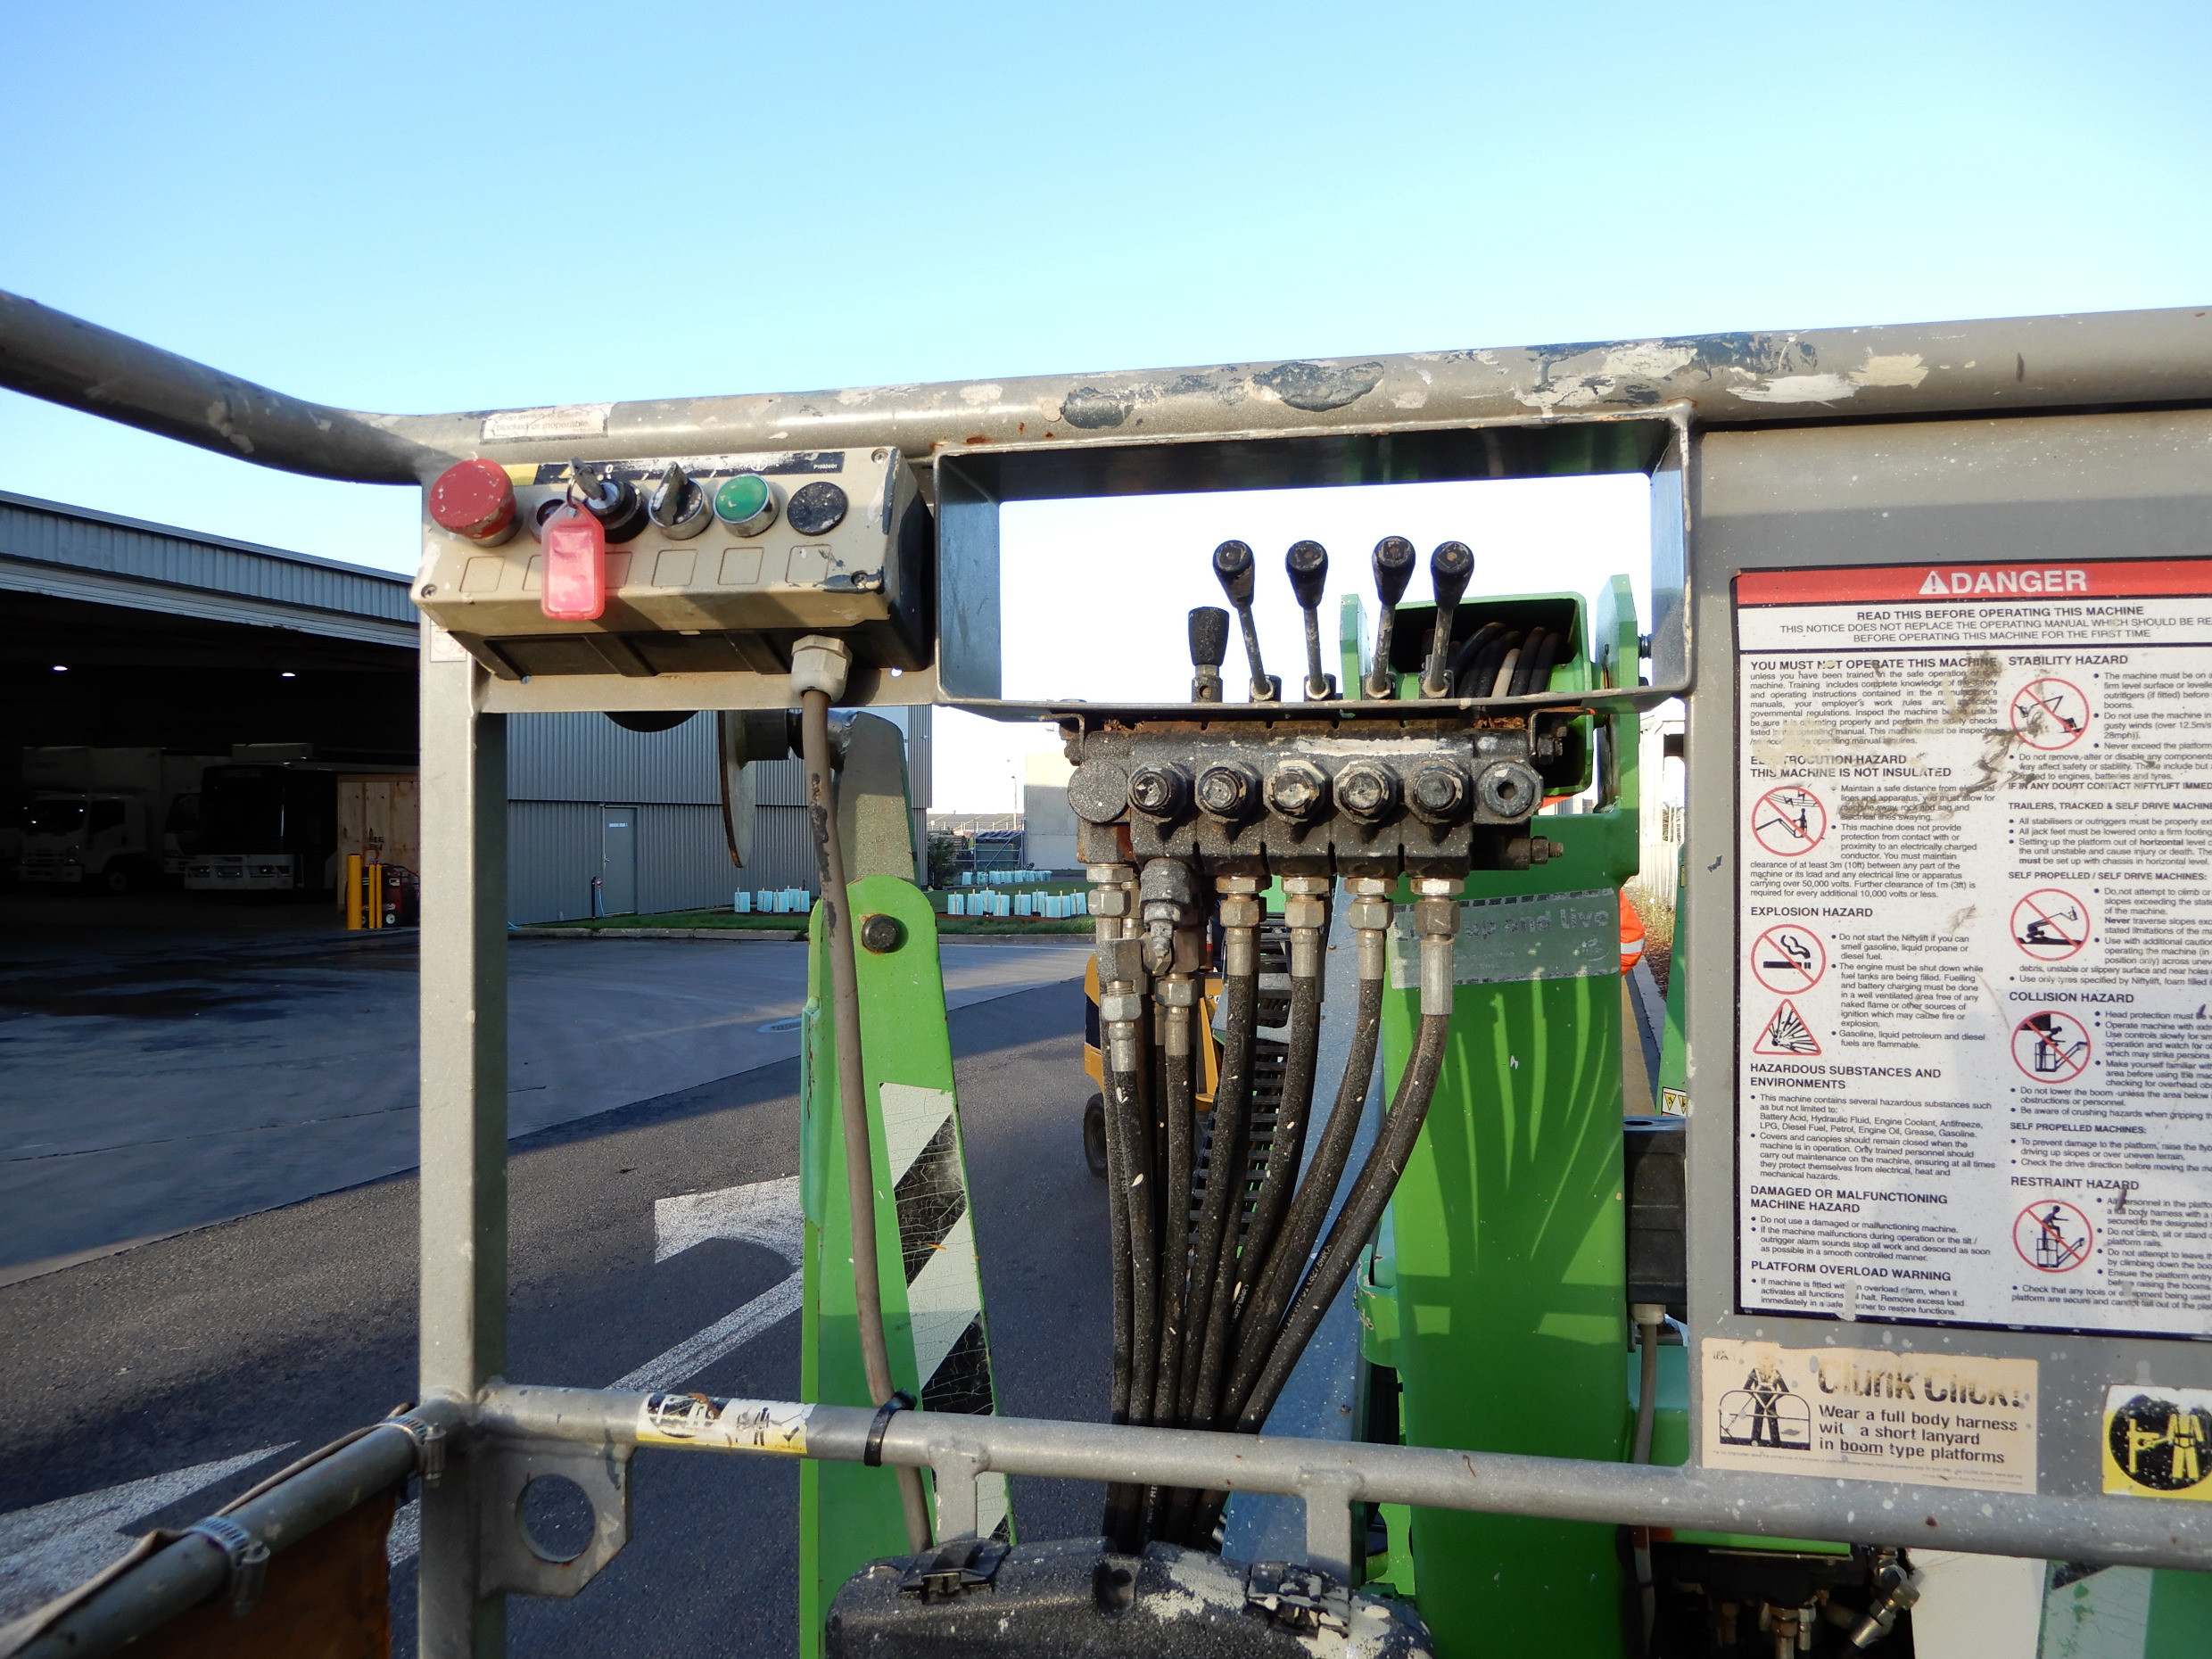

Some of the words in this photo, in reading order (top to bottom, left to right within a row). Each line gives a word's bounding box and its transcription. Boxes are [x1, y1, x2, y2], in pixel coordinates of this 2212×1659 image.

[496, 422, 529, 432] blocked
[1952, 570, 2087, 595] DANGER
[1857, 611, 1891, 621] READ
[1894, 610, 1922, 620] THIS
[1925, 609, 1976, 619] BEFORE
[1978, 607, 2051, 618] OPERATING
[2053, 607, 2083, 616] THIS
[2086, 606, 2144, 616] MACHINE
[1780, 625, 1803, 633] THIS
[1806, 624, 1845, 632] NOTICE
[1848, 623, 1878, 631] DOES
[1880, 623, 1902, 631] NOT
[1904, 622, 1953, 631] REPLACE
[1956, 621, 1977, 630] THE
[1979, 620, 2042, 629] OPERATING
[2044, 619, 2089, 628] MANUAL
[2091, 618, 2128, 627] WHICH
[2131, 617, 2176, 628] SHOULD
[2179, 617, 2194, 626] BE
[1853, 633, 1896, 642] BEFORE
[1899, 632, 1960, 641] OPERATING
[1962, 631, 1986, 640] THIS
[1990, 631, 2038, 640] MACHINE
[2042, 631, 2064, 640] FOR
[2067, 630, 2088, 639] THE
[2092, 630, 2122, 639] FIRST
[2125, 629, 2150, 638] TIME
[1751, 661, 1776, 671] YOU
[1779, 660, 1814, 671] MUST
[1817, 660, 1843, 670] NT
[1846, 659, 1904, 669] OPERATE
[1907, 658, 1936, 668] THIS
[2009, 656, 2072, 665] STABILITY
[2076, 655, 2128, 664] HAZARD
[1751, 755, 1854, 765] ELTROCUTION
[1853, 755, 1907, 764] HAZARD
[1750, 768, 1777, 778] THIS
[1780, 768, 1836, 778] MACHINE
[1839, 768, 1851, 778] IS
[1854, 768, 1879, 778] NOT
[2008, 802, 2057, 810] TRAILERS,
[2059, 802, 2104, 810] TRACKED
[2116, 802, 2139, 810] SELF
[2142, 802, 2170, 810] DRIVE
[1790, 861, 1797, 869] of
[1845, 862, 1865, 870] (10ft)
[1867, 862, 1901, 870] between
[1919, 863, 1936, 871] part
[1937, 862, 1945, 870] of
[2009, 871, 2032, 879] SELF
[2035, 871, 2091, 879] PROPELLED
[2124, 872, 2152, 880] DRIVE
[2155, 872, 2207, 880] MACHINES:
[1750, 889, 1782, 897] required
[1820, 889, 1858, 897] additional
[1861, 890, 1887, 898] 10,000
[1889, 890, 1908, 898] volts
[1751, 907, 1819, 917] EXPLOSION
[1822, 907, 1873, 917] HAZARD
[1463, 919, 1497, 939] up
[1504, 911, 1552, 934] and
[1559, 908, 1609, 929] live
[1839, 933, 1851, 941] Do
[1902, 934, 1928, 944] Niftylift
[1931, 934, 1936, 942] if
[2010, 991, 2077, 1003] COLLISION
[2081, 993, 2134, 1003] HAZARD
[1750, 1063, 1826, 1075] HAZARDOUS
[1829, 1065, 1912, 1077] SUBSTANCES
[1915, 1069, 1941, 1078] AND
[1750, 1077, 1846, 1089] ENVIRONMENTS
[1760, 1122, 1779, 1131] LPG,
[1782, 1123, 1806, 1131] Diesel
[1809, 1124, 1828, 1133] Fuel,
[1830, 1125, 1855, 1134] Petrol,
[1859, 1126, 1886, 1135] Engine
[1888, 1126, 1902, 1135] Oil,
[1904, 1127, 1936, 1137] Grease,
[1938, 1128, 1977, 1138] Gasoline.
[2010, 1122, 2033, 1130] SELF
[2035, 1123, 2092, 1133] PROPELLED
[2094, 1125, 2147, 1134] MACHINES:
[2010, 1176, 2083, 1188] RESTRAINT
[2086, 1179, 2140, 1191] HAZARD
[1750, 1185, 1812, 1198] DAMAGED
[1815, 1188, 1833, 1199] OR
[1836, 1189, 1948, 1205] MALFUNCTIONING
[1751, 1199, 1805, 1210] MACHINE
[1809, 1201, 1861, 1213] HAZARD
[1751, 1260, 1816, 1274] PLATFORM
[1820, 1264, 1888, 1278] OVERLOAD
[1891, 1268, 1952, 1282] WARNING
[1817, 1356, 1916, 1400] Clunk
[1819, 1404, 1861, 1420] Wear
[1865, 1410, 1875, 1421] a
[1880, 1407, 1905, 1424] full
[1911, 1411, 1950, 1430] body
[1955, 1416, 2018, 1432] harness
[1819, 1422, 1858, 1436] wit
[1860, 1425, 1869, 1437] a
[1874, 1425, 1916, 1440] short
[1921, 1429, 1980, 1447] lanyard
[1819, 1437, 1834, 1450] in
[1840, 1439, 1884, 1455] boom
[1888, 1442, 1925, 1458] type
[1930, 1445, 2005, 1465] platforms
